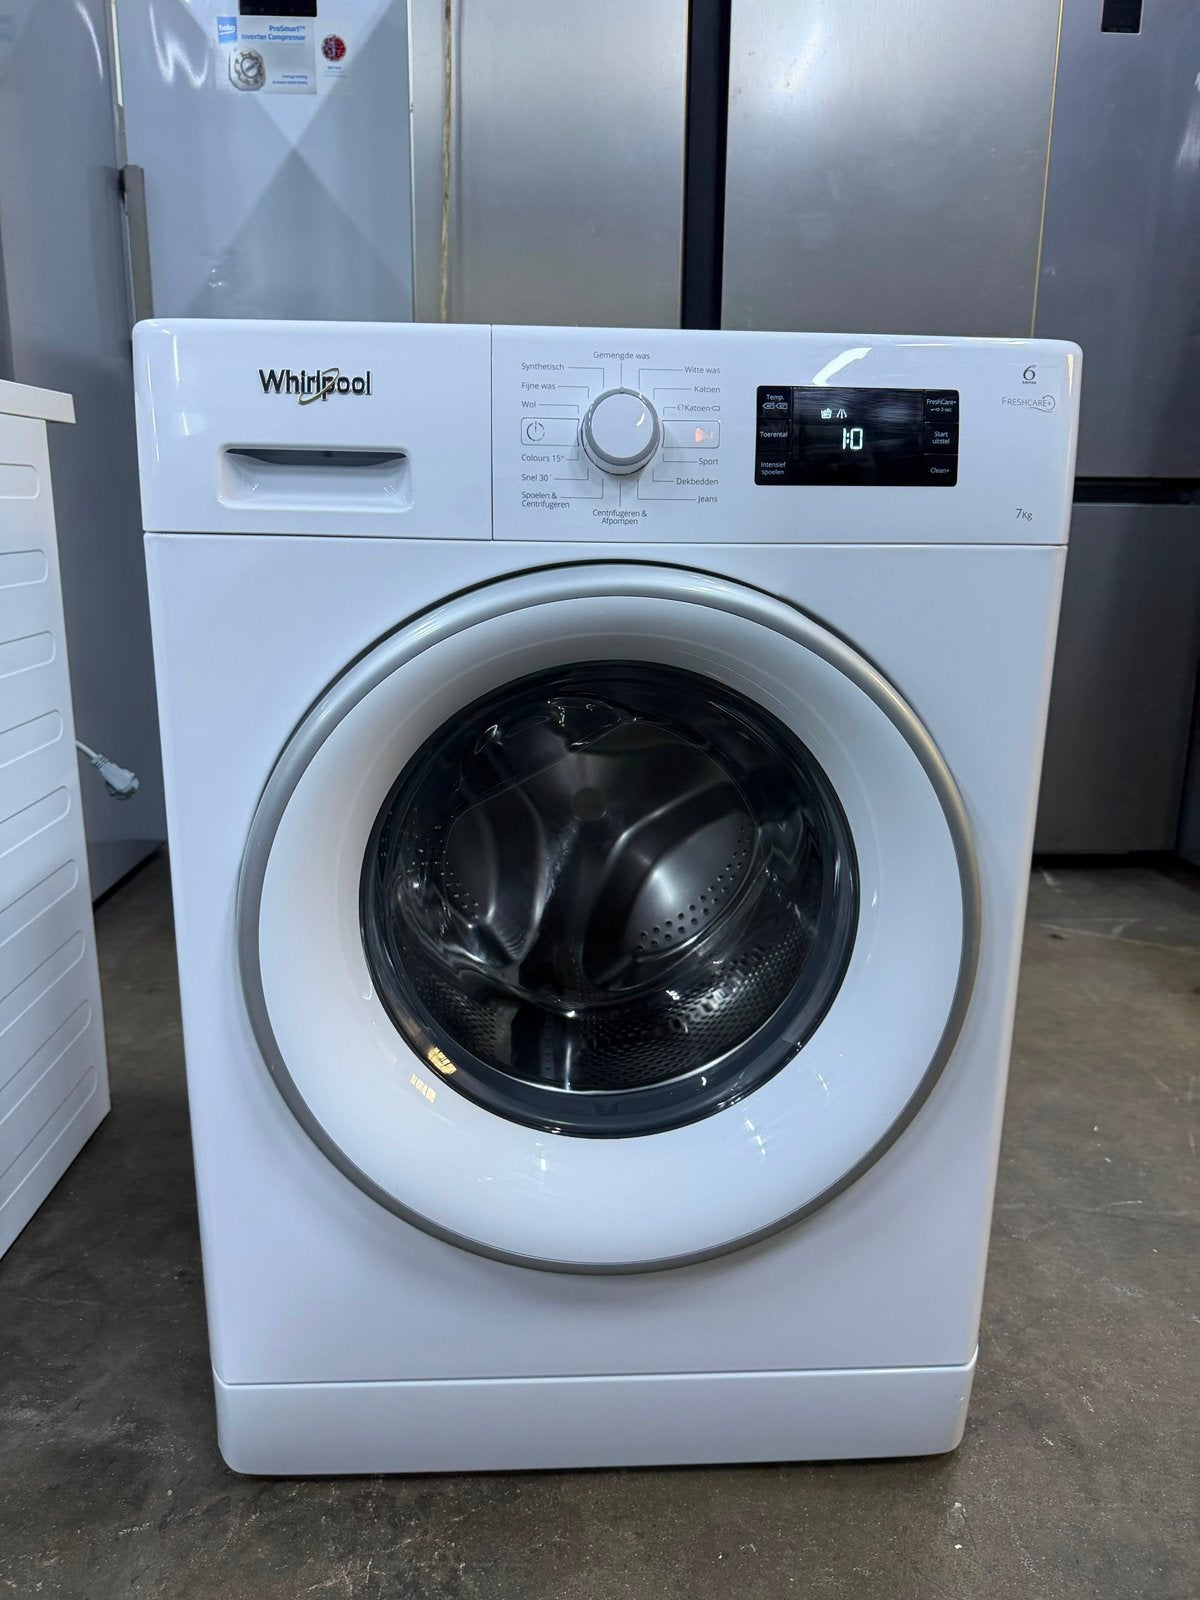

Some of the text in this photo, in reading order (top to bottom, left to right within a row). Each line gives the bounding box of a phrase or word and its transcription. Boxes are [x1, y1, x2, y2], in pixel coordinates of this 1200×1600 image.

[593, 351, 634, 361] Gemengde
[521, 362, 565, 371] Synthetisch
[684, 366, 704, 374] Witte
[1023, 364, 1037, 381] 6
[258, 368, 373, 402] Whirlpool
[521, 382, 540, 391] Fijne
[694, 385, 721, 393] Katoen
[766, 394, 785, 402] Temp.
[521, 400, 537, 408] Wol
[684, 404, 711, 412] Katoen
[842, 427, 864, 450] 1:0
[521, 453, 550, 462] Colours
[698, 458, 719, 466] Sport
[521, 473, 538, 481] Snel
[521, 491, 550, 500] Spoelen
[698, 495, 718, 503] Jeans
[521, 499, 570, 510] Centrifugeren
[592, 508, 640, 518] Centrifugeren
[601, 517, 639, 526] Afpompen
